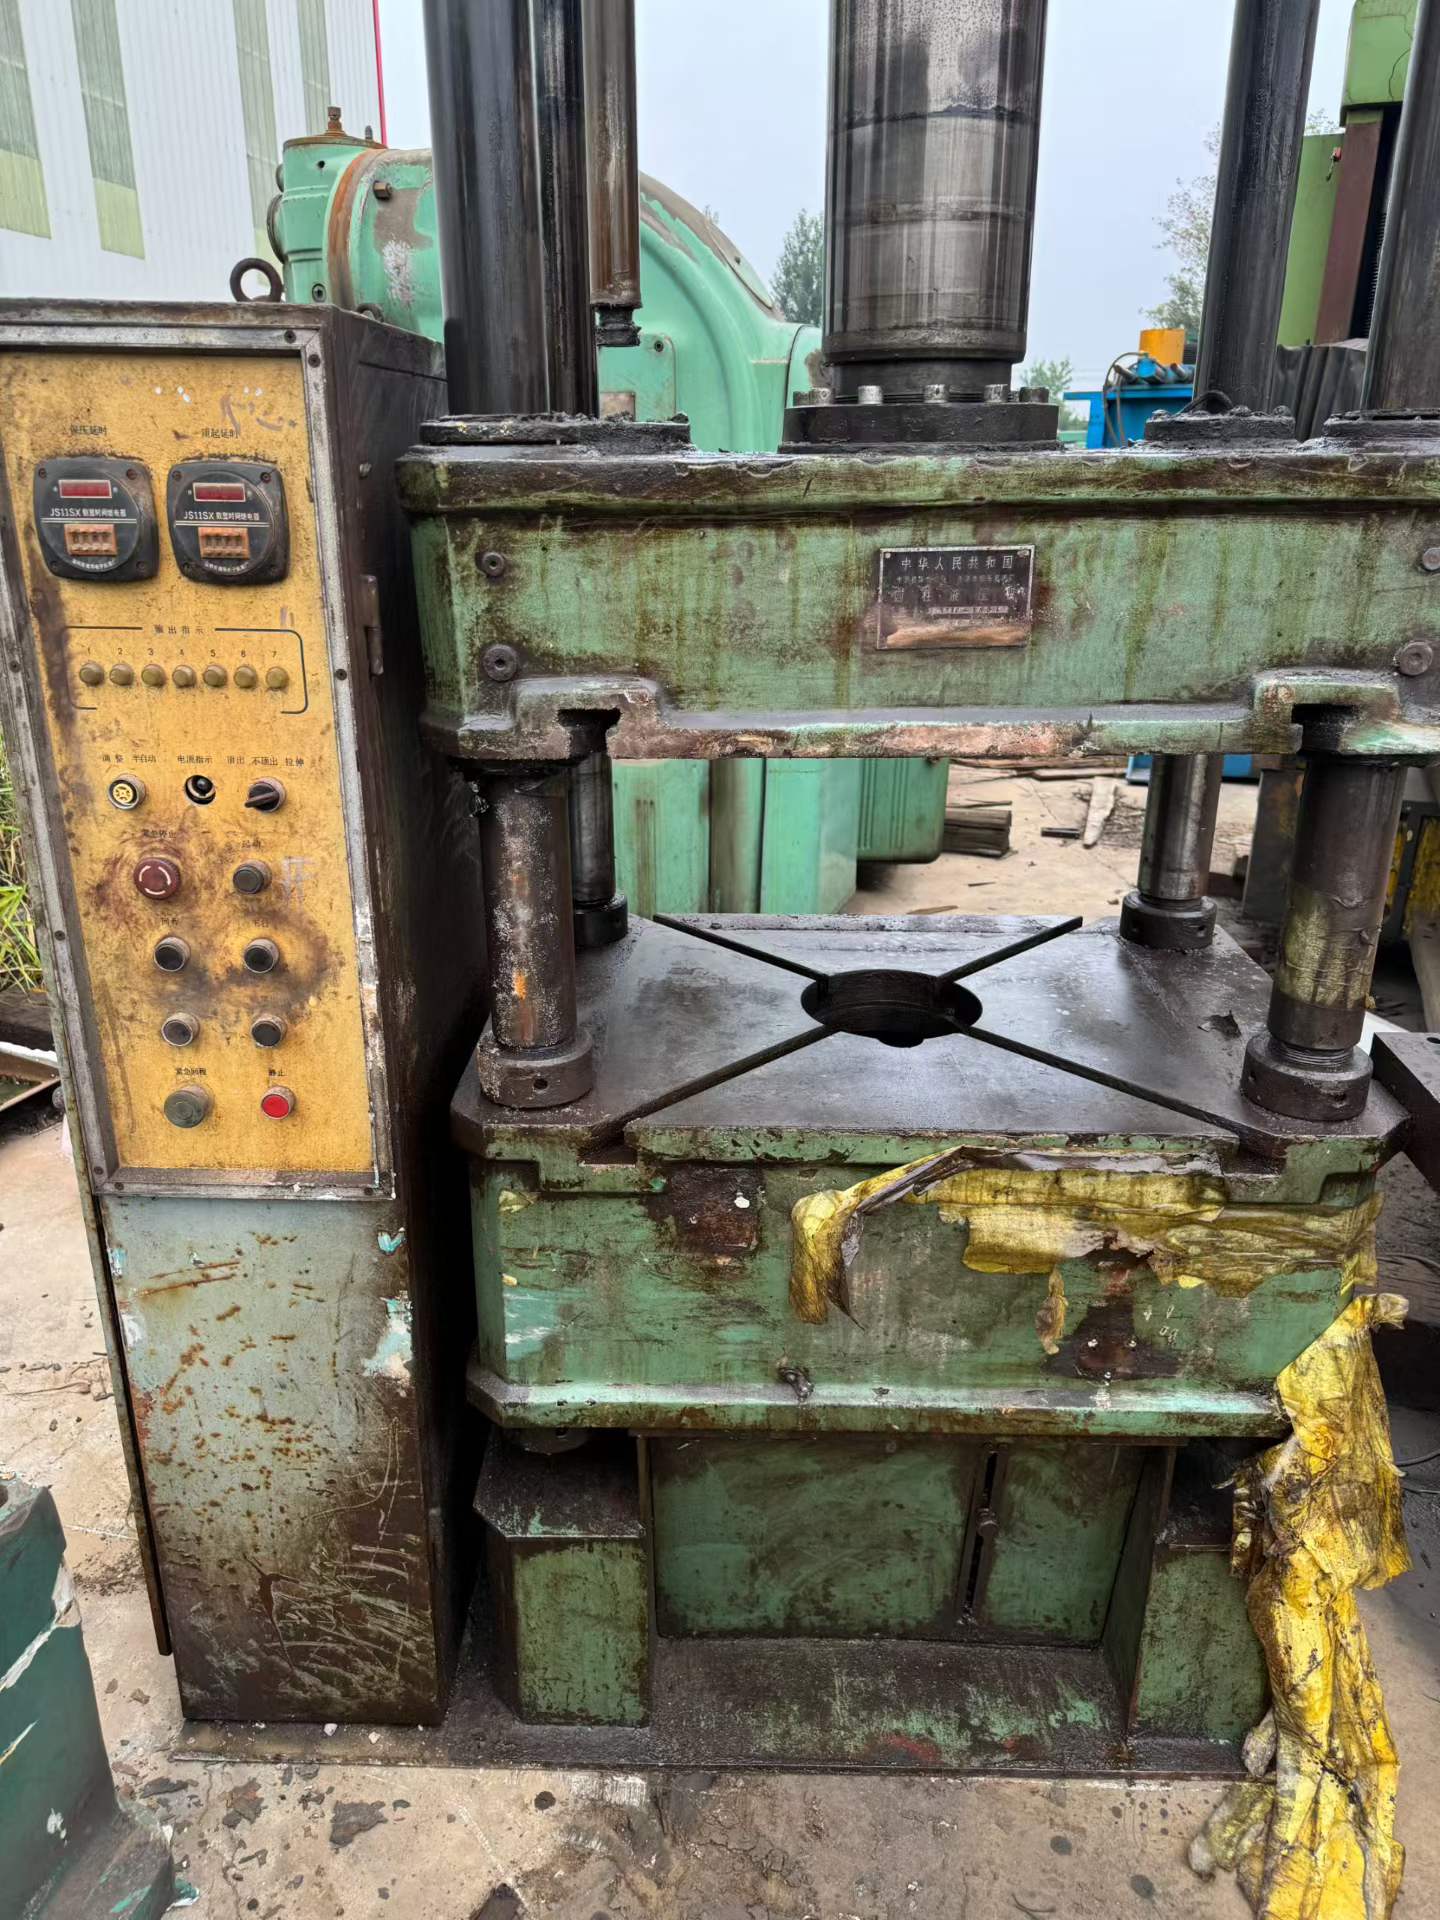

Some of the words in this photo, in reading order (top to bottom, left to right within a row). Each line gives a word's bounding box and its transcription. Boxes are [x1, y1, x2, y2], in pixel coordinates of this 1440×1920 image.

[50, 508, 81, 517] JS11SX
[184, 511, 214, 520] JS11SX
[901, 555, 1013, 571] 中华人民共和国
